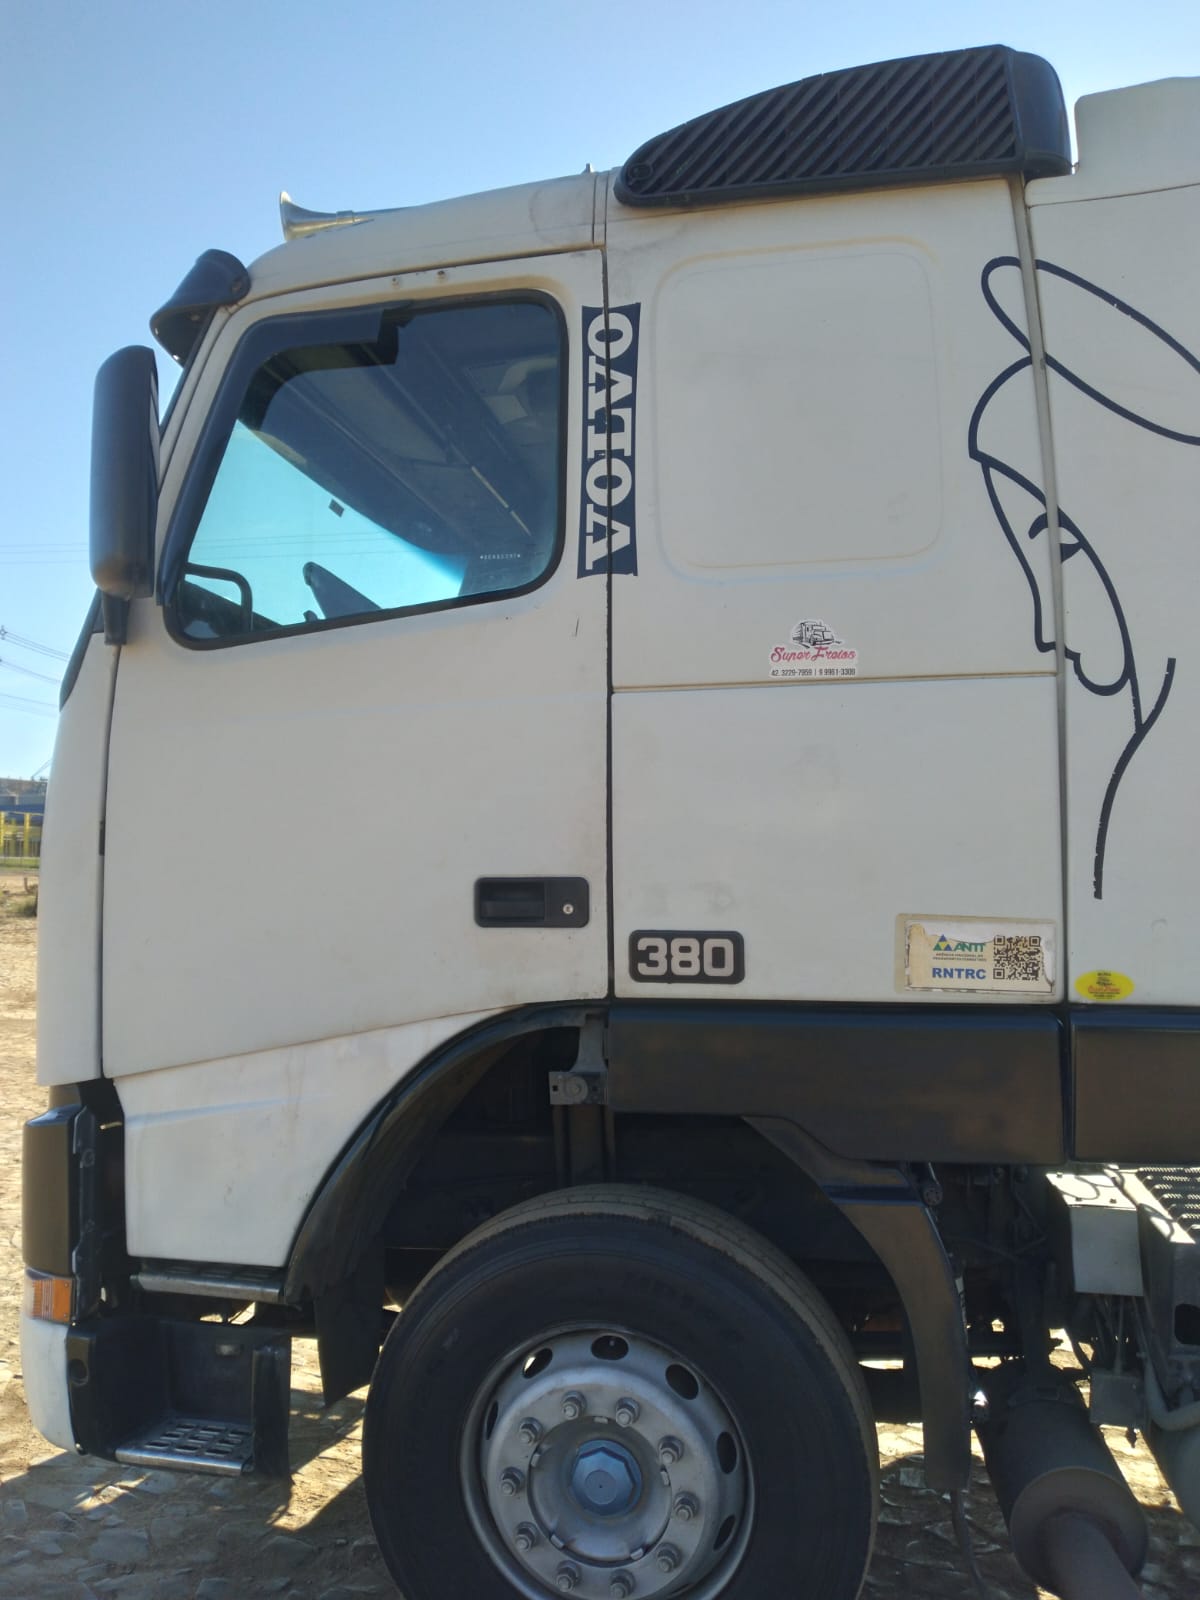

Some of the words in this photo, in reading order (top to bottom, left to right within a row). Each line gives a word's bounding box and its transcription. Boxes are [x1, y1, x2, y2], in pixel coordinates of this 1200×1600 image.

[585, 312, 633, 570] VOLVO
[637, 937, 735, 977] 380
[953, 942, 986, 952] ANTT
[932, 967, 987, 980] RNTRC
